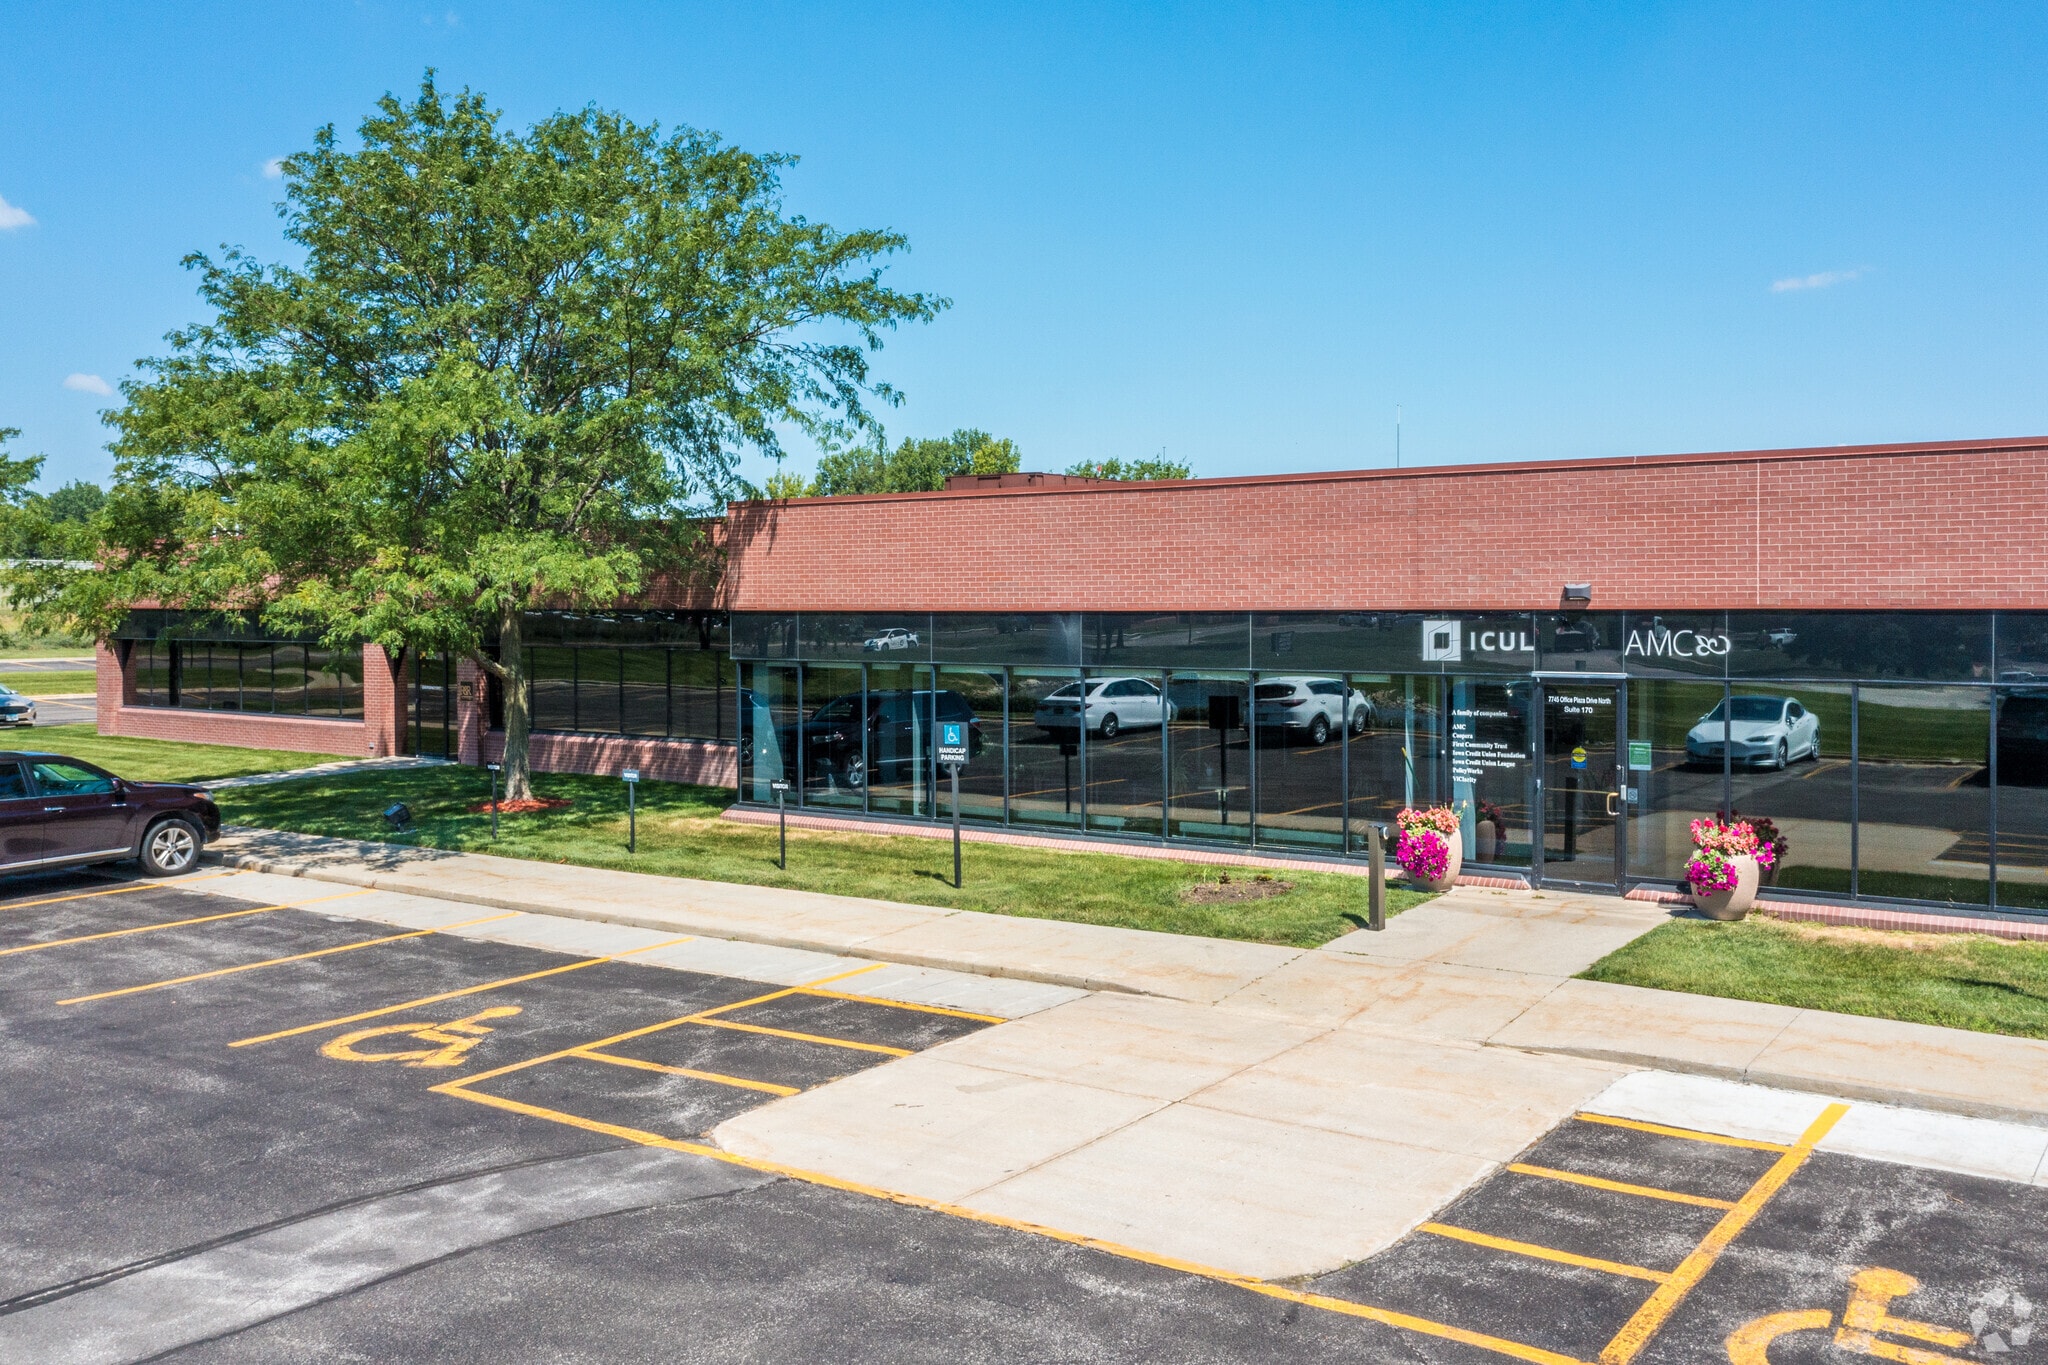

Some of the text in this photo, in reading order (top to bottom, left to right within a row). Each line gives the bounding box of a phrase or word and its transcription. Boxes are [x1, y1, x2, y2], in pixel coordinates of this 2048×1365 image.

[1470, 631, 1535, 651] ICUL
[1573, 696, 1585, 704] Plaza
[1457, 709, 1472, 717] family
[1564, 705, 1593, 714] Suite 170
[1465, 742, 1493, 750] Community
[1497, 760, 1516, 768] League
